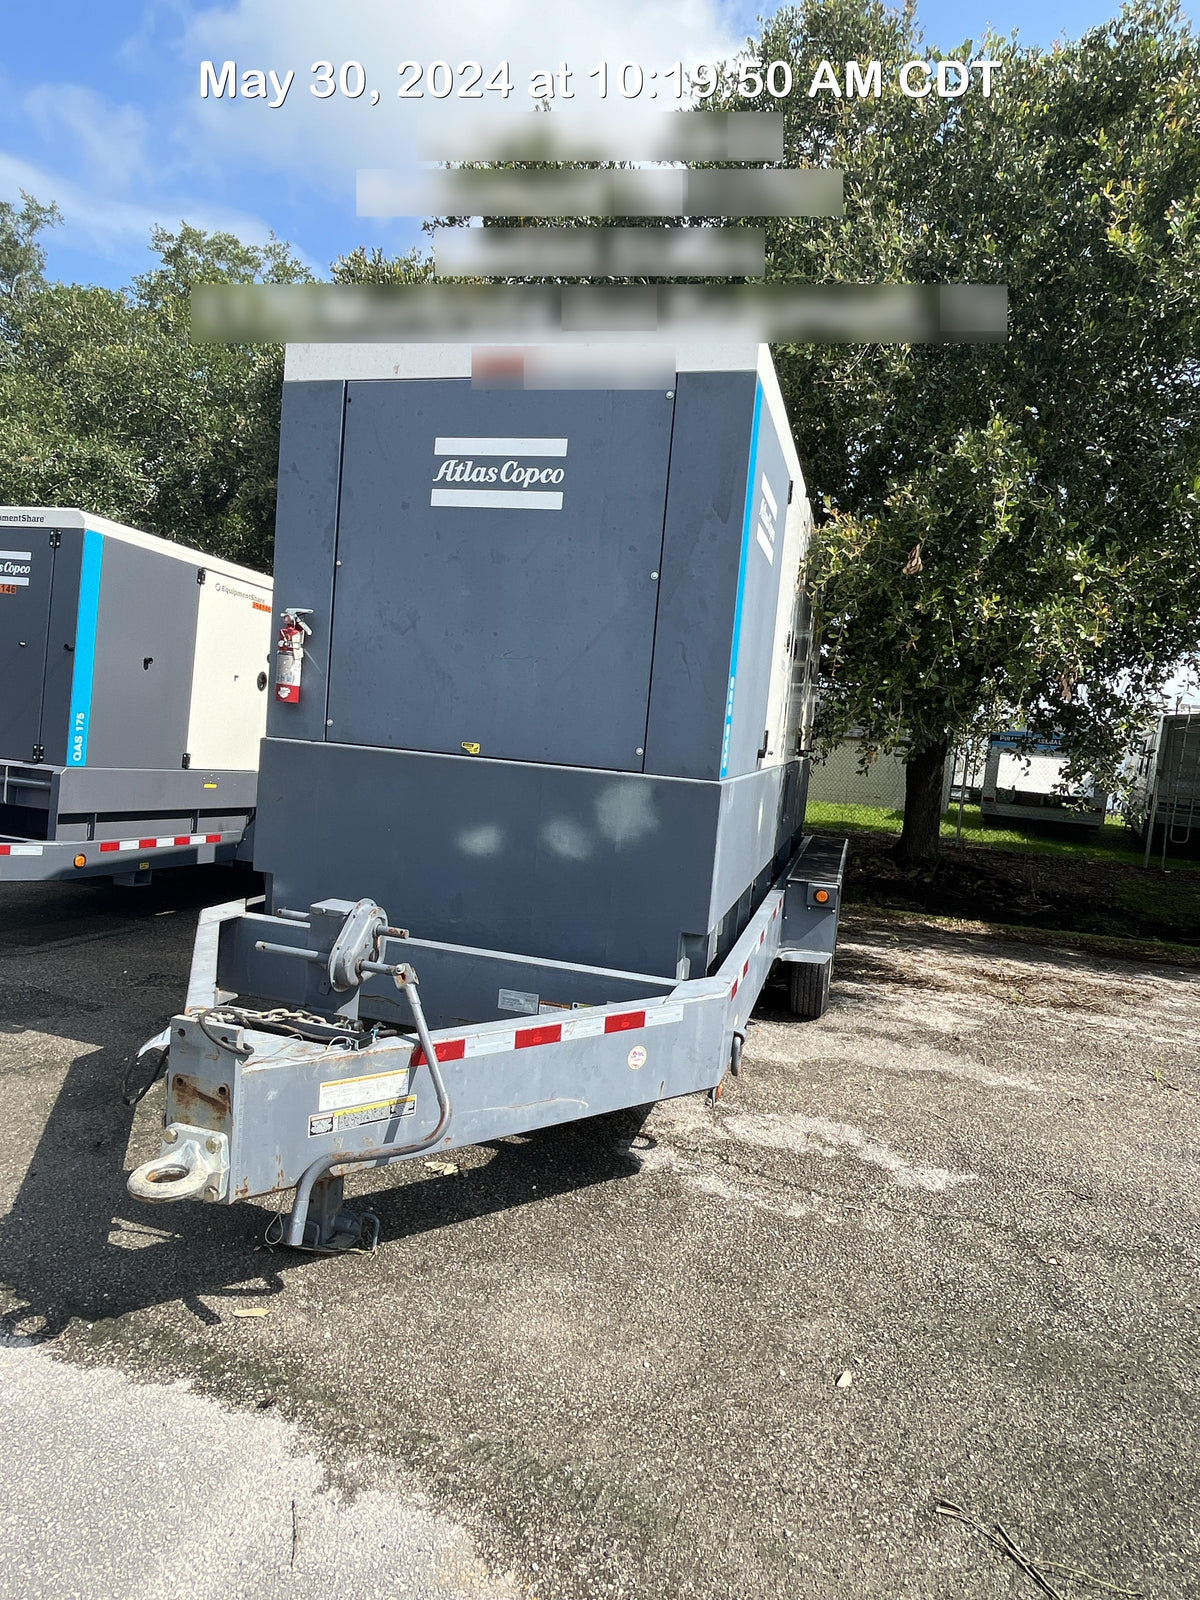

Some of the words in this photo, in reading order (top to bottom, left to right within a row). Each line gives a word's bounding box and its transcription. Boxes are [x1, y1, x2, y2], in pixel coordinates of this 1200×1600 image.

[432, 459, 498, 482] Atlas
[500, 460, 565, 488] Copco
[0, 514, 45, 523] mentShare
[4, 561, 31, 576] Copco
[75, 712, 85, 732] 175
[72, 735, 83, 762] QAS
